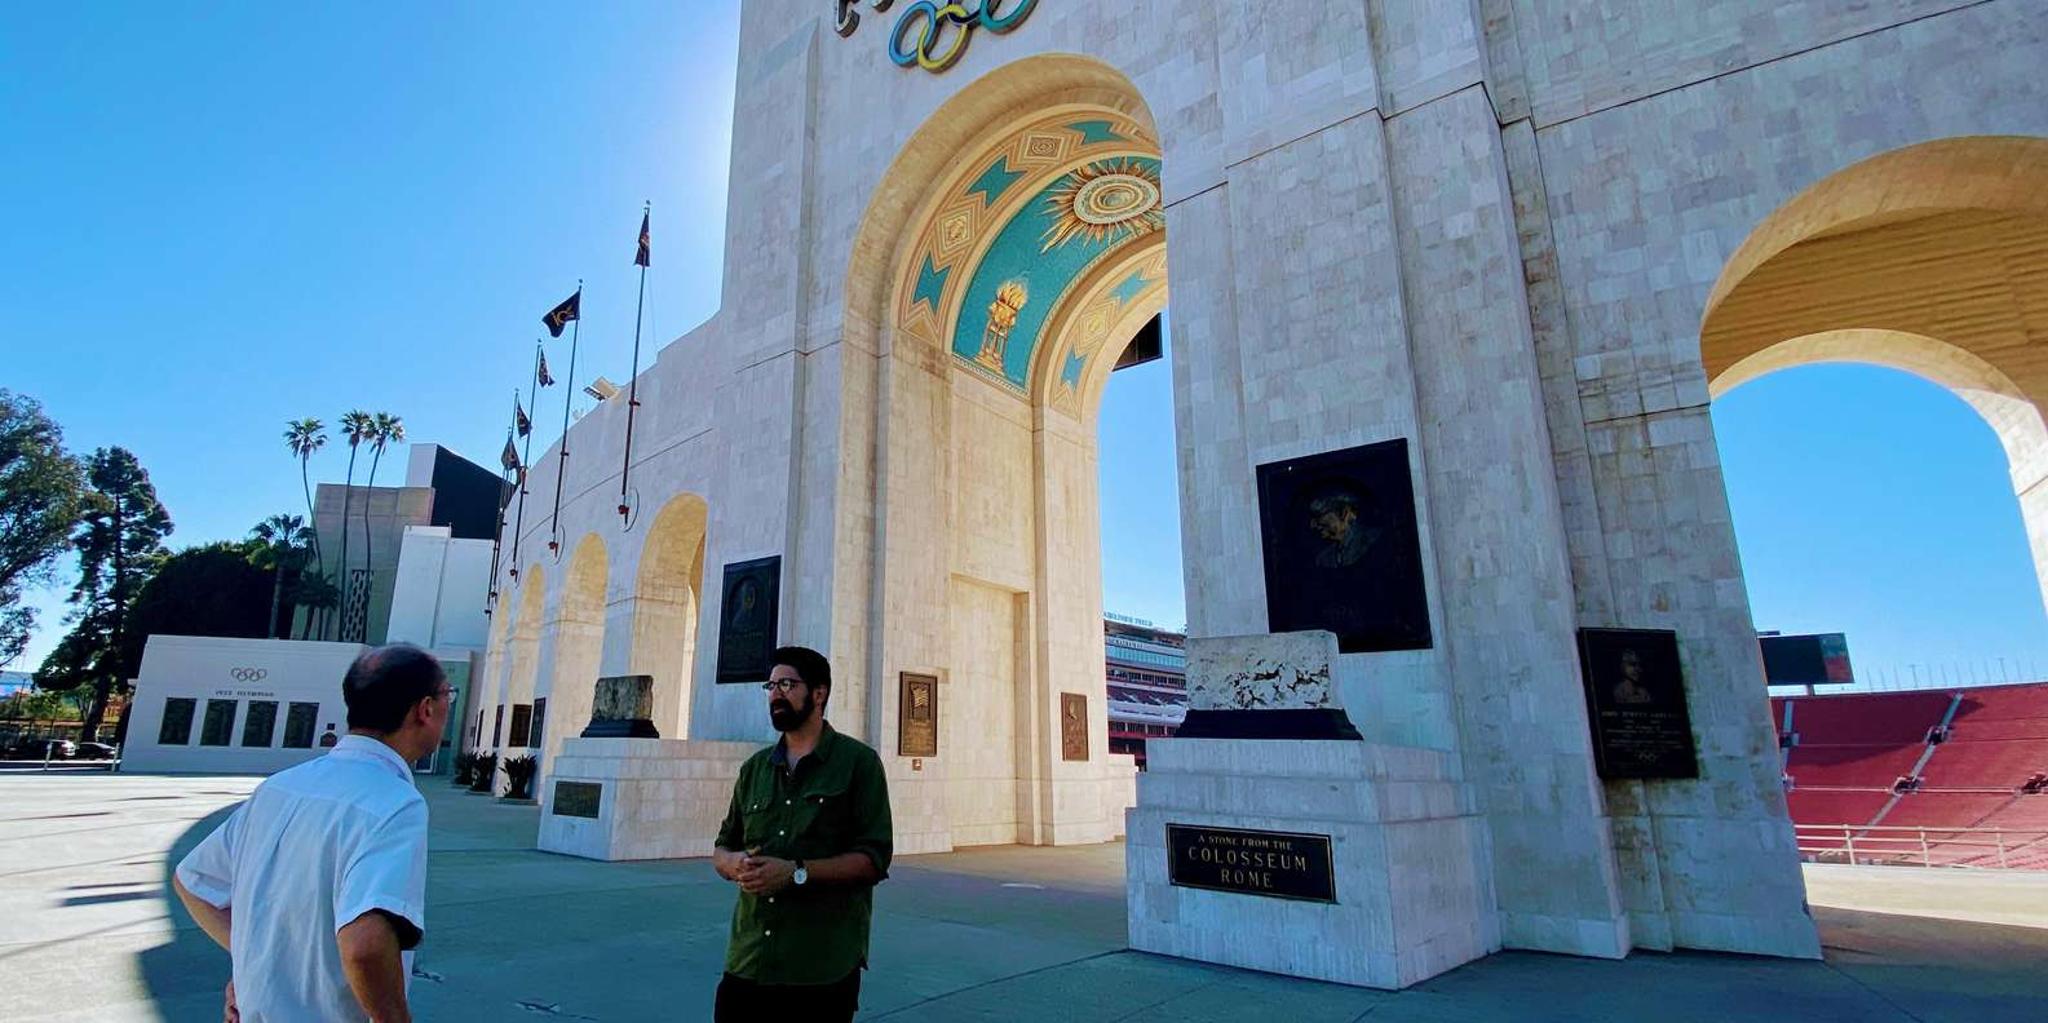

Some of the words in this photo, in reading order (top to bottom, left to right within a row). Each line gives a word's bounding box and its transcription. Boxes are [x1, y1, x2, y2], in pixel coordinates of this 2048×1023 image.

[1198, 834, 1205, 843] A
[1209, 835, 1237, 846] STONE
[1241, 838, 1269, 848] FROM
[1273, 840, 1293, 850] THE
[1188, 846, 1306, 872] COLOSSEUM
[1220, 868, 1273, 888] ROME
